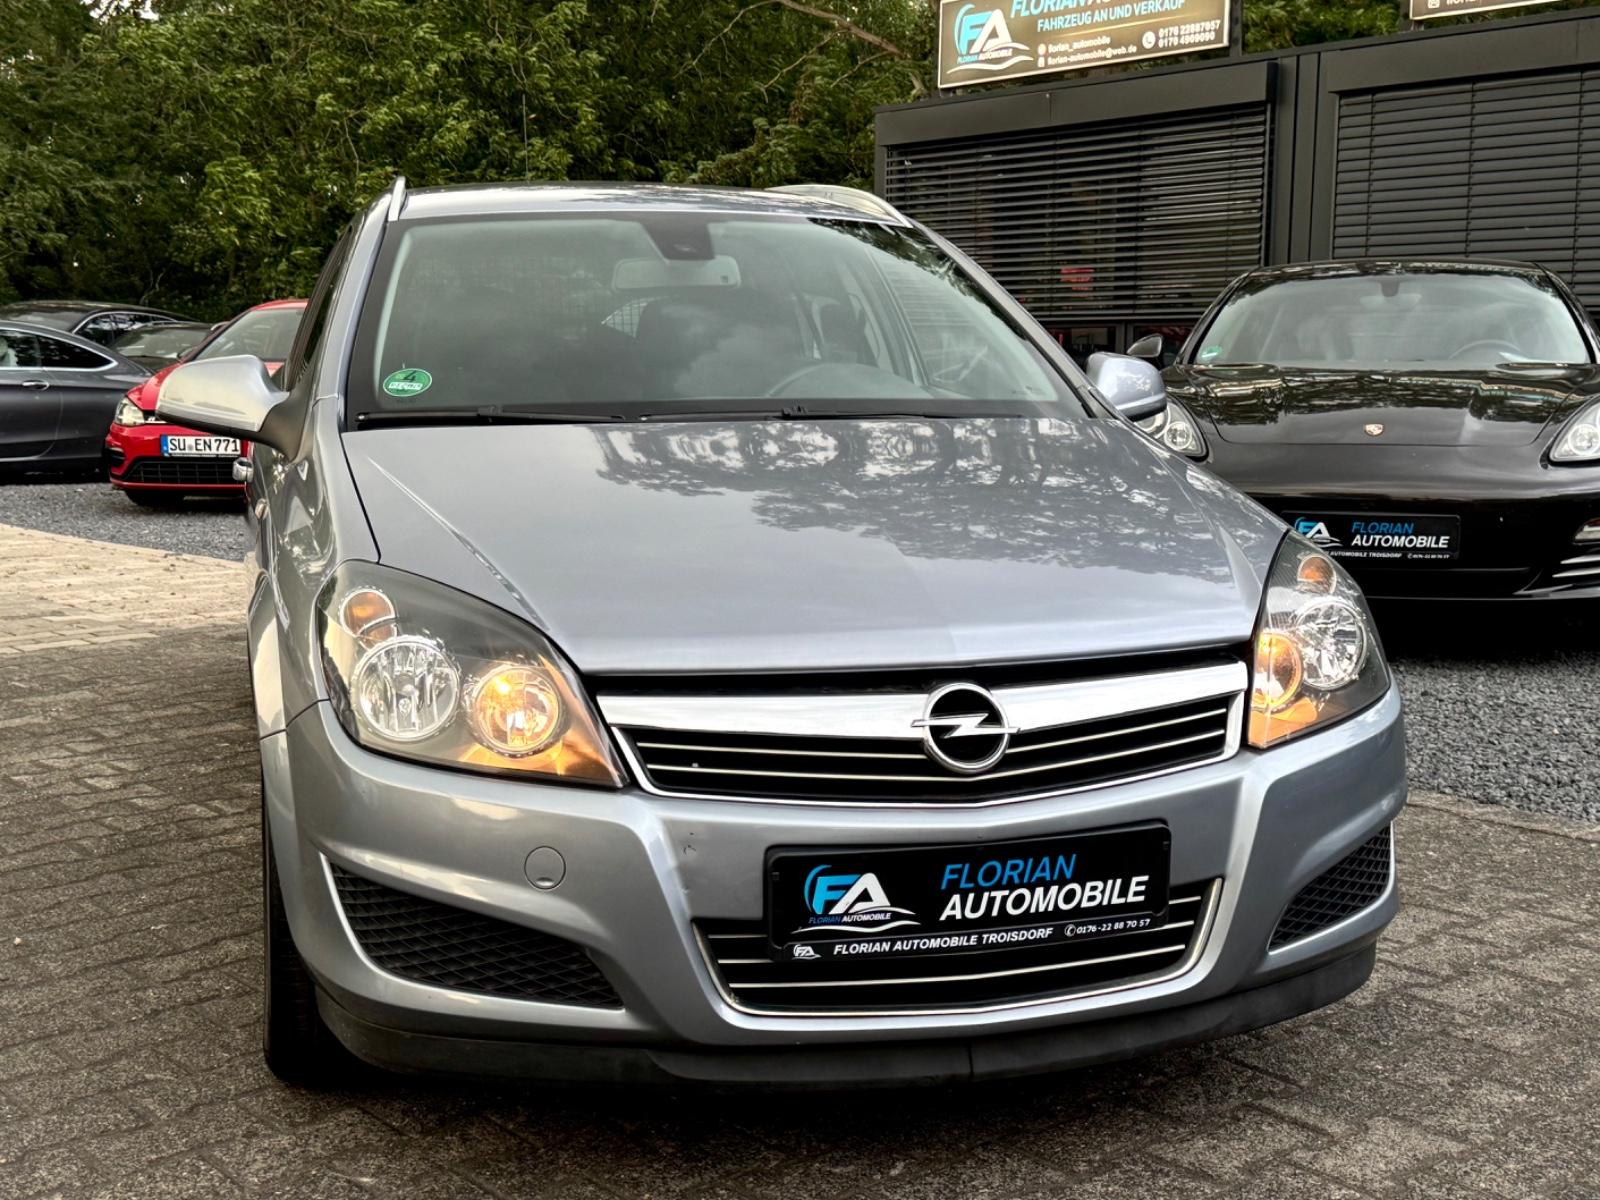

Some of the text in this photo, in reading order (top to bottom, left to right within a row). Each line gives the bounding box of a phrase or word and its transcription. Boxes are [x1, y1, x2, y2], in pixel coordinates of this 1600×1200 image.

[1037, 0, 1185, 32] FAHRZEUG AN UND VERKAUF
[169, 438, 186, 452] SU
[1351, 521, 1414, 534] FLORIAN
[1351, 534, 1450, 549] AUTOMOBILE
[940, 853, 1077, 891] FLORIAN
[812, 872, 891, 915] FA
[939, 875, 1150, 922] AUTOMOBILE
[808, 912, 892, 924] FLORIAN AUTOMOBILE
[833, 941, 891, 955] FLORIAN
[892, 935, 978, 951] AUTOMOBILE
[981, 927, 1054, 945] TROISDORF
[1113, 921, 1125, 930] 88
[1126, 920, 1138, 929] 70
[1139, 918, 1151, 927] 57
